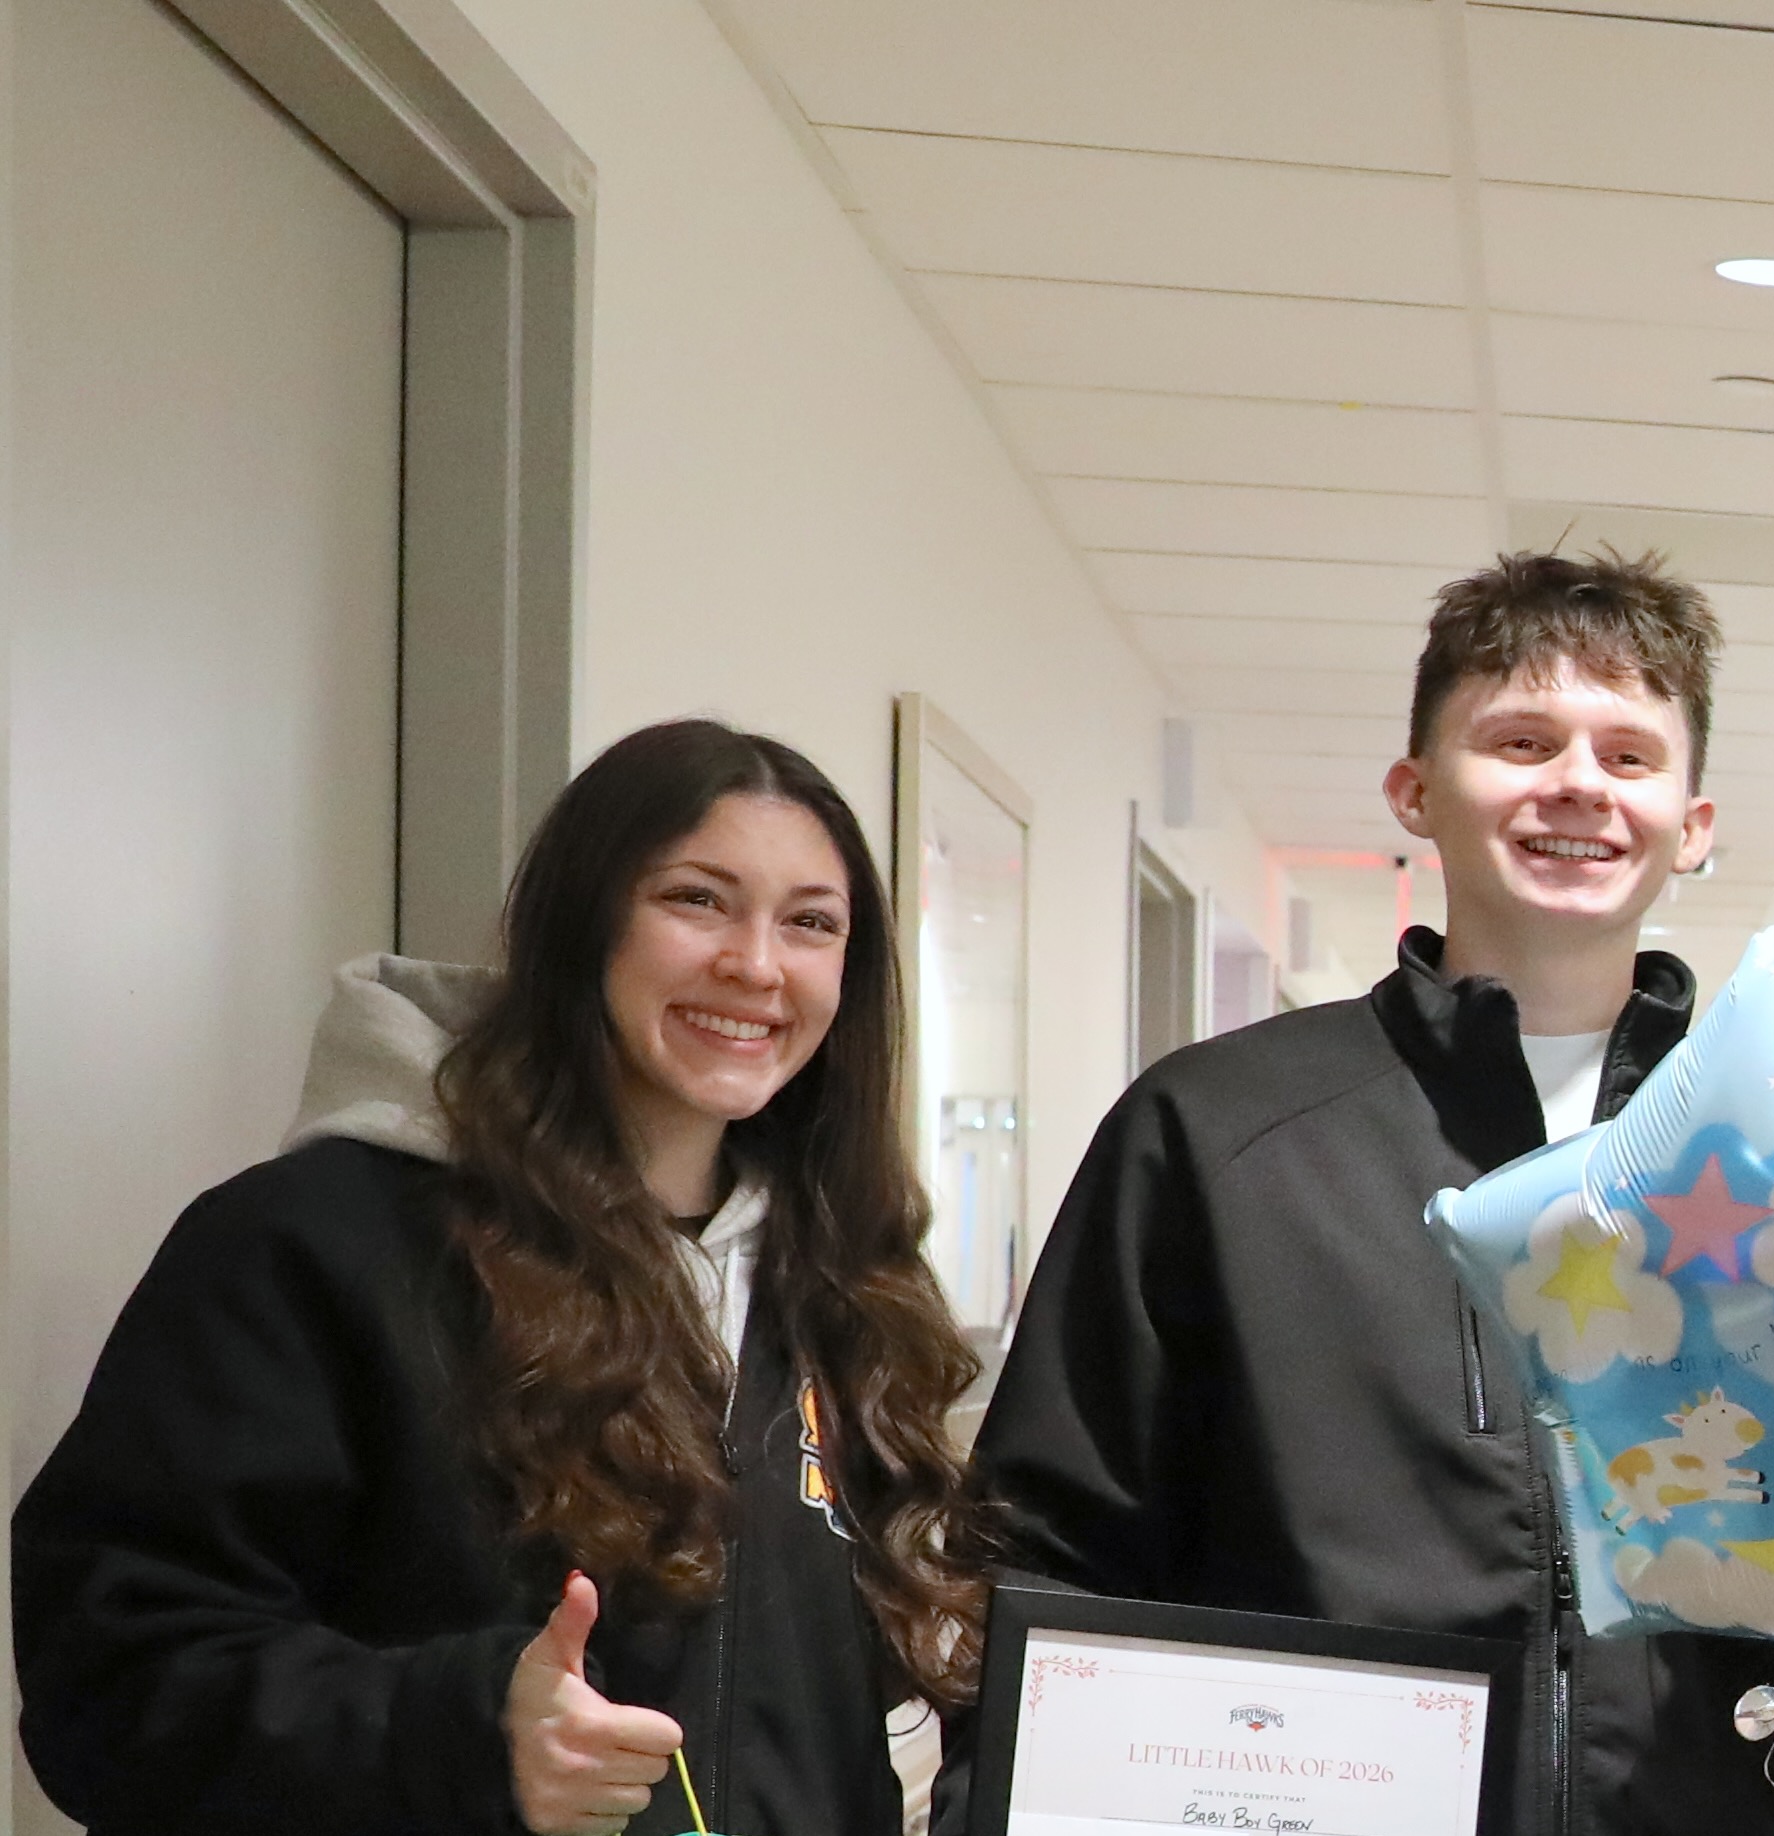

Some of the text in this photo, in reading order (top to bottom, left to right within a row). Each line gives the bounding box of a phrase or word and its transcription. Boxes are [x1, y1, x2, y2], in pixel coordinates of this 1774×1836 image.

[1128, 1743, 1395, 1784] LITTLE HAWK OF 2026
[1193, 1788, 1213, 1796] THIS
[1243, 1792, 1280, 1801] CERTIFY
[1283, 1795, 1306, 1803] THAT
